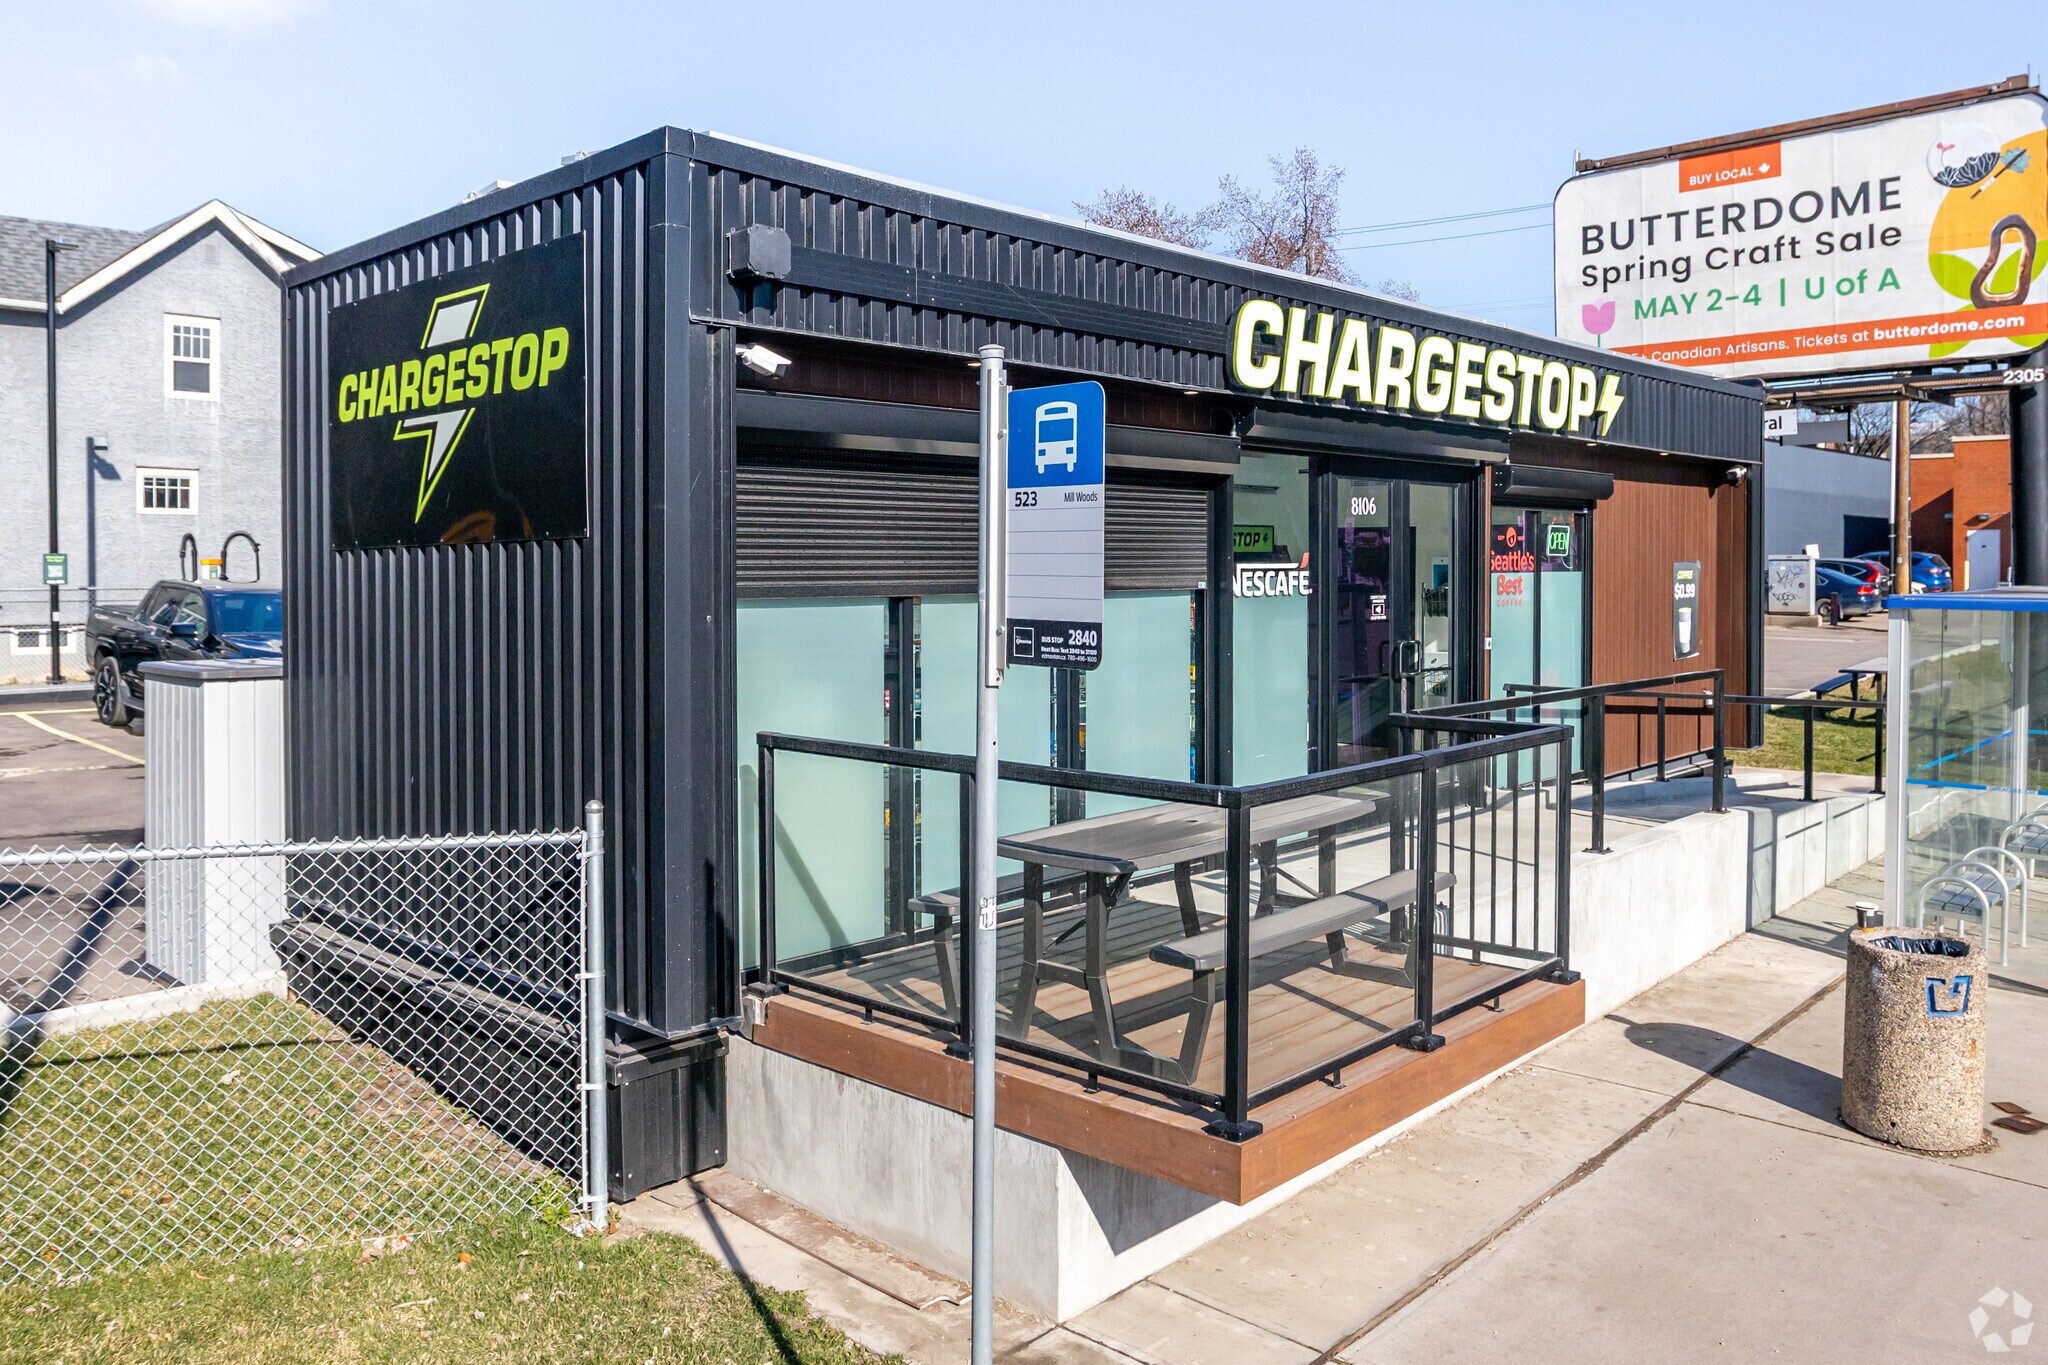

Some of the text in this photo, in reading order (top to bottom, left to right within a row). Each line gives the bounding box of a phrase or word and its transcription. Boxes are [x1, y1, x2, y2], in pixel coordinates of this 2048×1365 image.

[1689, 166, 1753, 186] BUY LOCAL
[1582, 175, 1902, 255] BUTTERDOME
[1582, 223, 1902, 293] Spring Craft Sale
[1634, 292, 1698, 320] MAY
[1651, 344, 1721, 362] Canadian
[1725, 340, 1790, 355] Artisans.
[1793, 332, 1848, 349] Tickets
[1851, 330, 1869, 343] at
[1874, 316, 2025, 341] butterdome.com
[338, 327, 569, 423] CHARGESTOP
[1232, 299, 1598, 432] CHARGESTOP
[2003, 368, 2045, 384] 2305
[1014, 491, 1098, 507] 523 Mill Woods
[1351, 497, 1377, 515] 8106
[1549, 532, 1569, 549] OPEN
[1497, 574, 1523, 595] Best
[1675, 583, 1695, 600] $0.99
[1497, 598, 1524, 607] COFFEE
[1068, 629, 1097, 646] 2840
